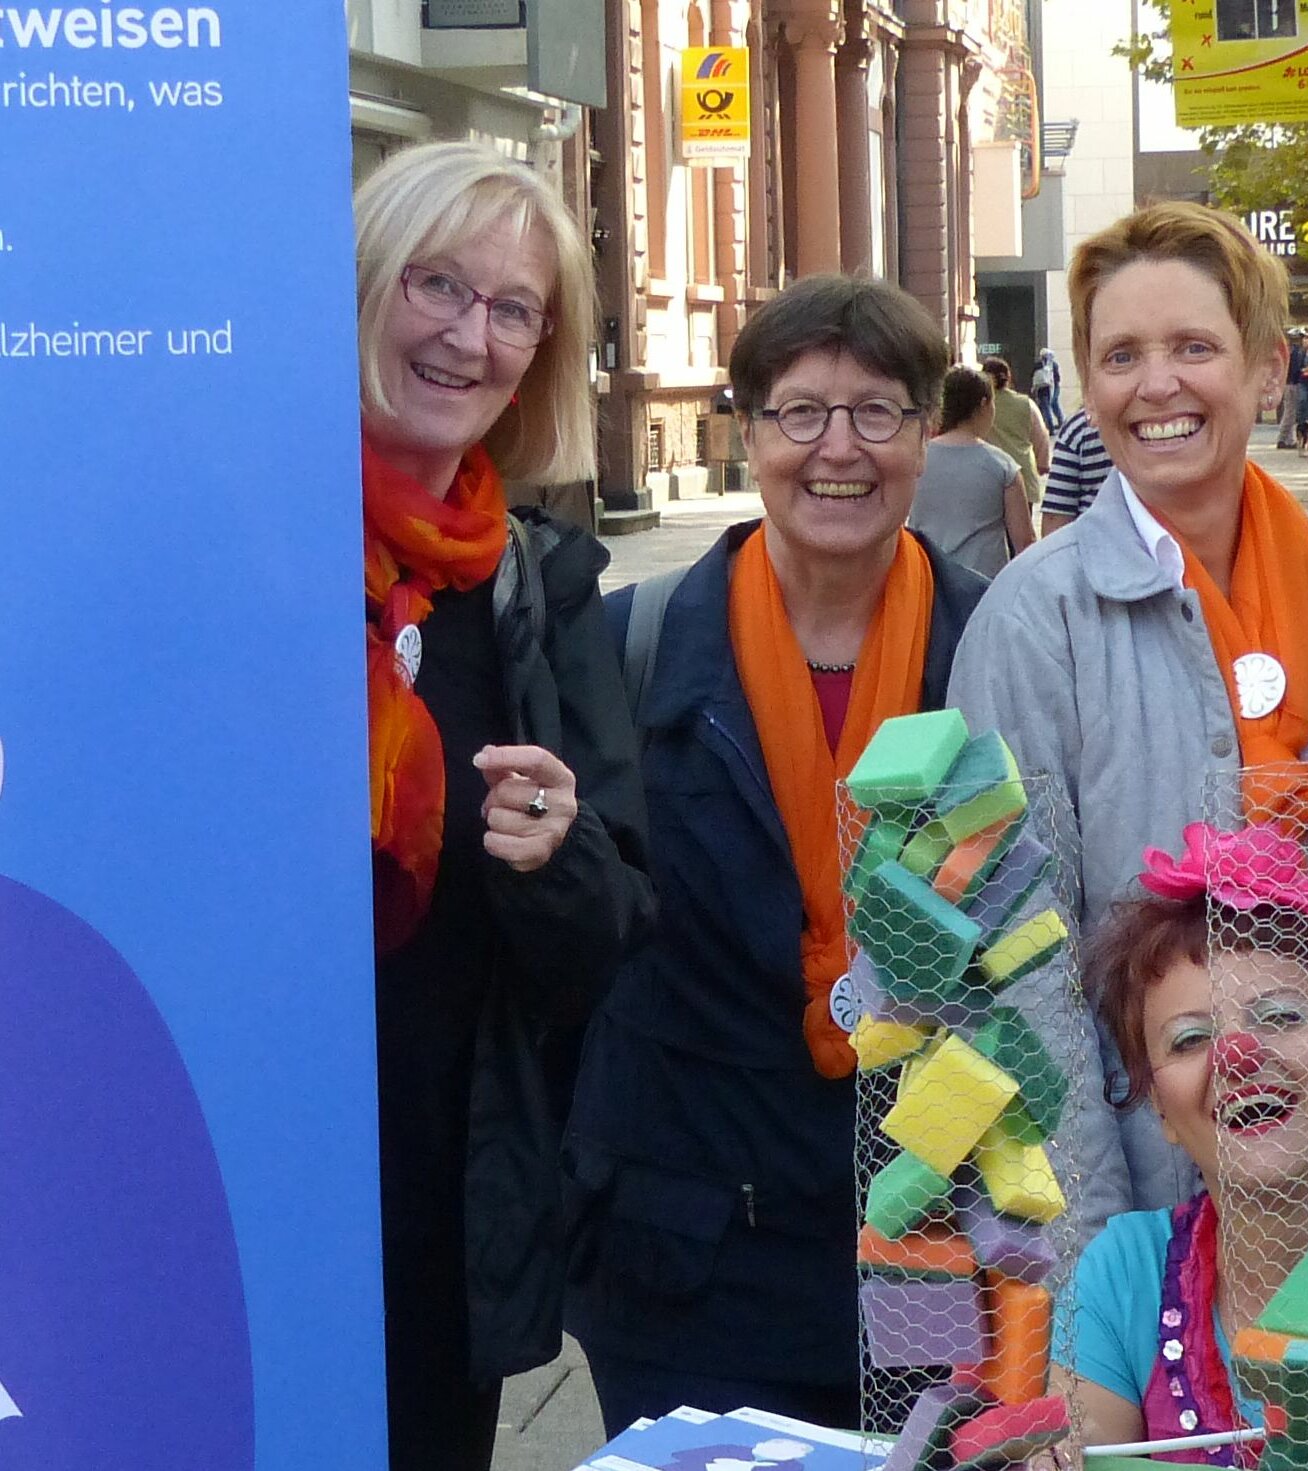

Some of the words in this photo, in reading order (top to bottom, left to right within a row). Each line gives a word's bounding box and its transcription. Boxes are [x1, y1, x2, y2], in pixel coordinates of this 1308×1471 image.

[3, 71, 135, 112] richten,
[149, 81, 223, 107] was
[698, 128, 733, 137] DHL
[1260, 243, 1296, 256] ING
[0, 321, 152, 357] lzheimer
[168, 320, 233, 355] und
